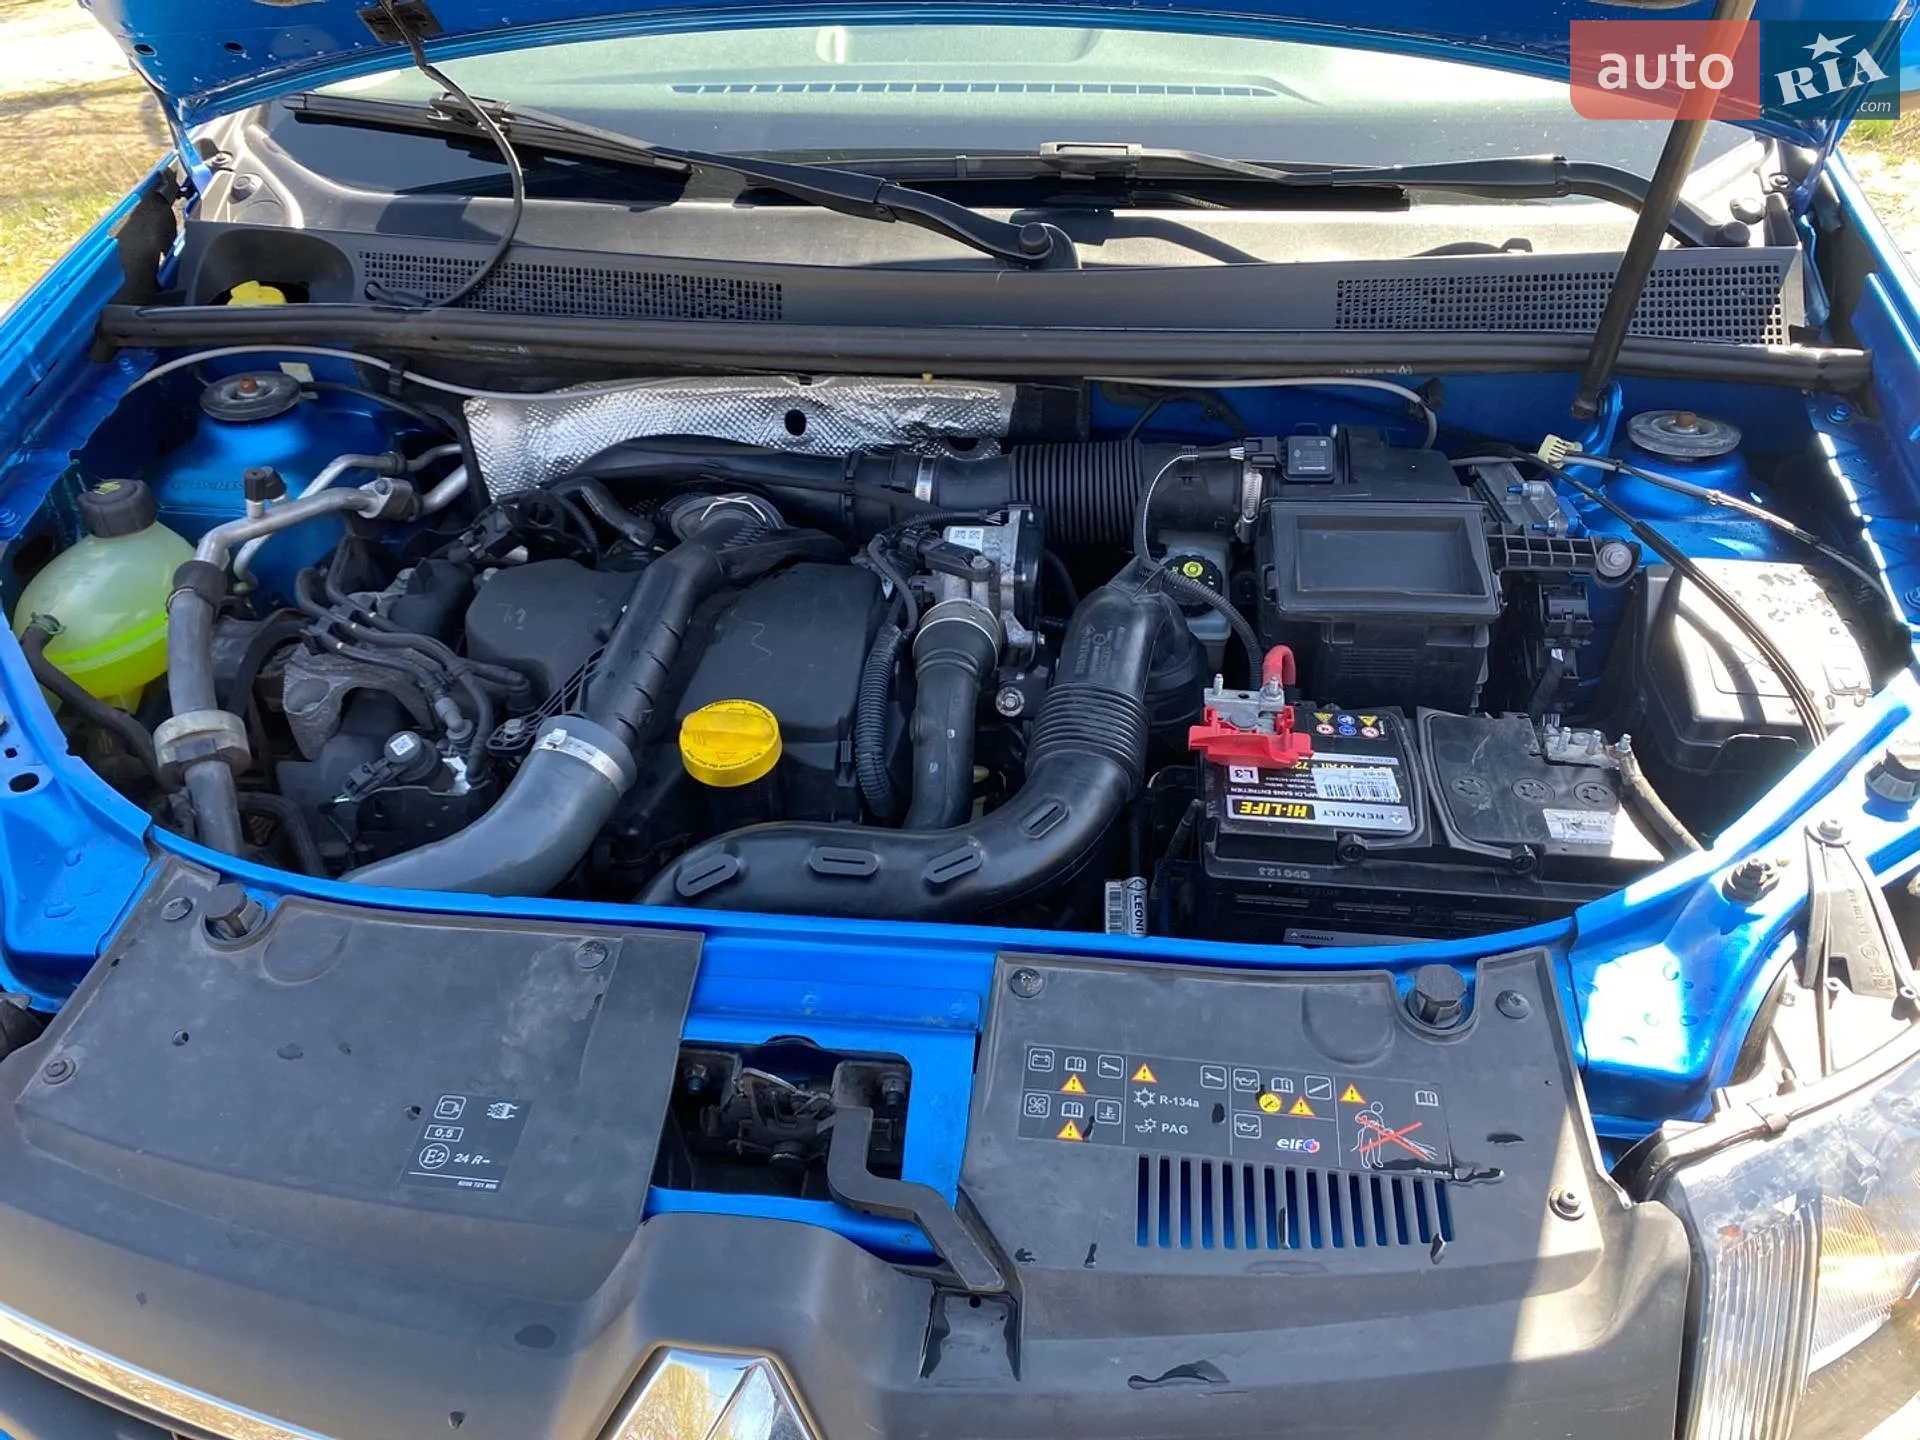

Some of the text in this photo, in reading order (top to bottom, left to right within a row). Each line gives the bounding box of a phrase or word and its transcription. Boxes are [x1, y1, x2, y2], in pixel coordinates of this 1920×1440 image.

[1234, 768, 1254, 780] L3
[1321, 808, 1385, 821] RENAULT
[1133, 894, 1145, 932] LEONI
[1159, 1094, 1199, 1108] R-134a
[1161, 1122, 1189, 1135] PAG
[1276, 1137, 1303, 1150] elf
[423, 1149, 445, 1163] E2
[453, 1153, 470, 1164] 24
